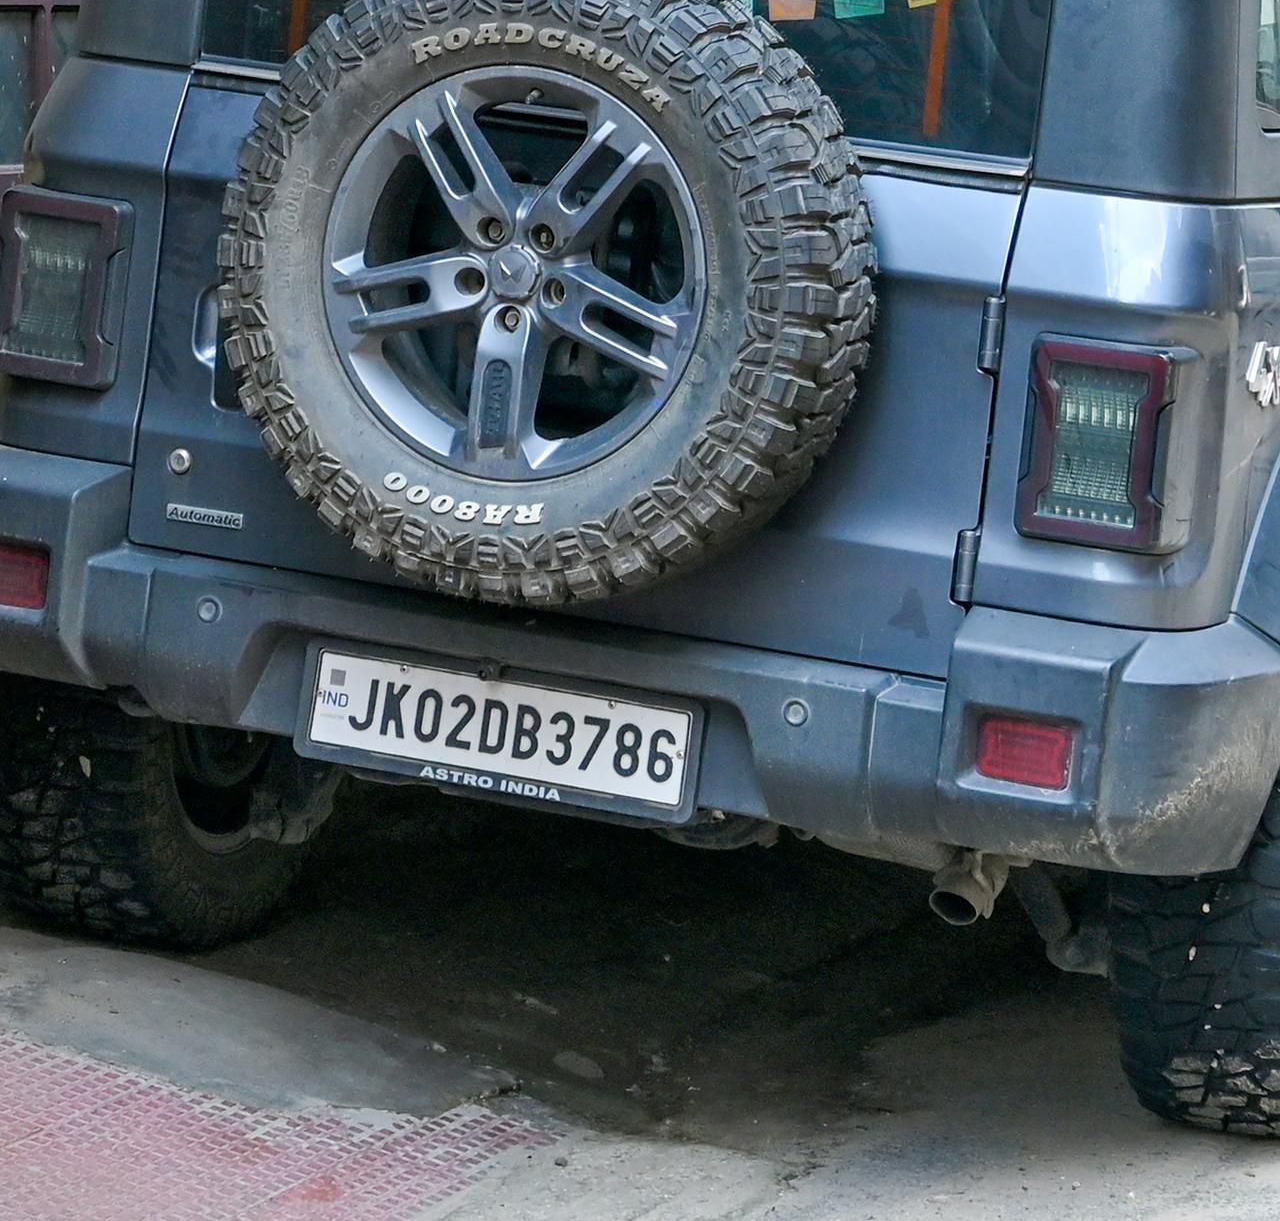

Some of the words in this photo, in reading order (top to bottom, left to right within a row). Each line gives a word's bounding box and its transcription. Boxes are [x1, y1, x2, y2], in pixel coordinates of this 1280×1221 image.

[411, 22, 671, 113] ROADCRUZA
[168, 506, 241, 527] Automatic
[383, 472, 544, 525] RA8000
[319, 690, 349, 709] IND
[348, 679, 677, 783] JK02DB3786
[420, 764, 494, 789] ASTRO
[499, 779, 562, 802] INDIA
